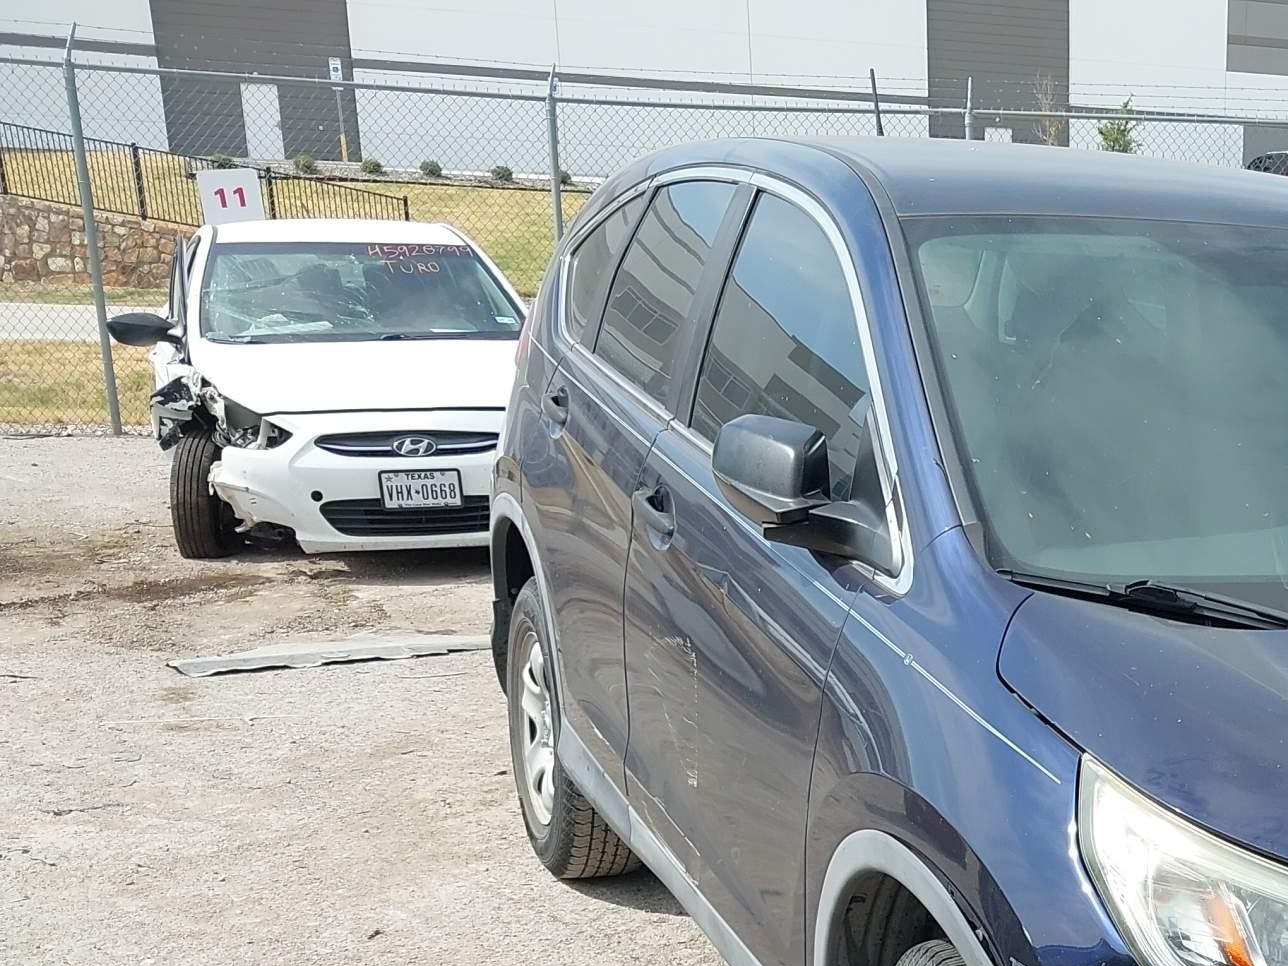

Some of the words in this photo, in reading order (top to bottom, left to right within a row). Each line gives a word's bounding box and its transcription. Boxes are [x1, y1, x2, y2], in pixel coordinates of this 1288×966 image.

[213, 186, 247, 209] 11
[380, 259, 440, 274] TURO
[404, 472, 436, 481] TEXAS
